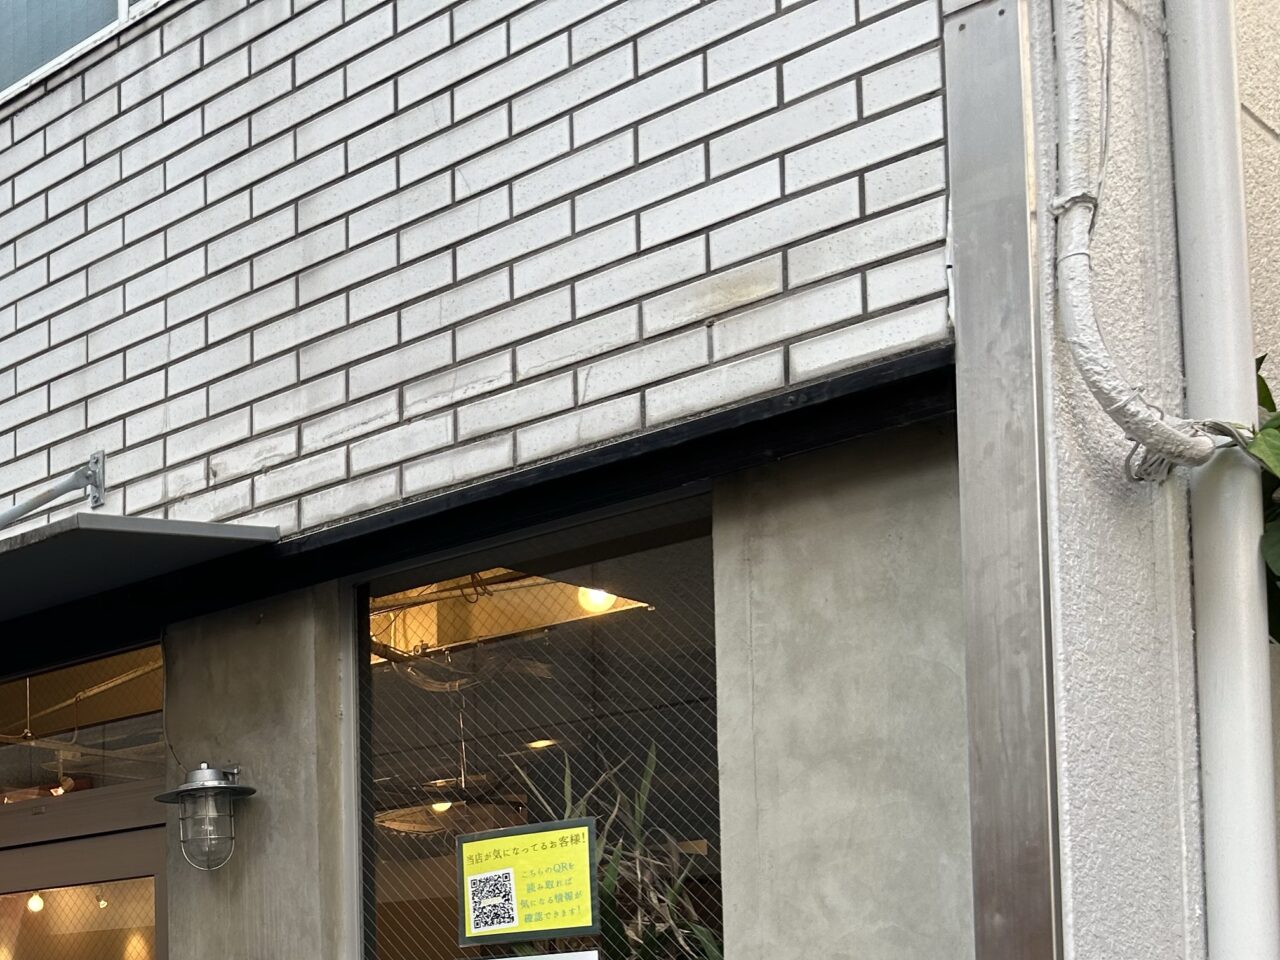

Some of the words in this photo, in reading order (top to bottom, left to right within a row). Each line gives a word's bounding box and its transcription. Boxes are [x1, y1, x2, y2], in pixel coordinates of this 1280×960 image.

[466, 832, 587, 865] 当店が気になってるお客様!
